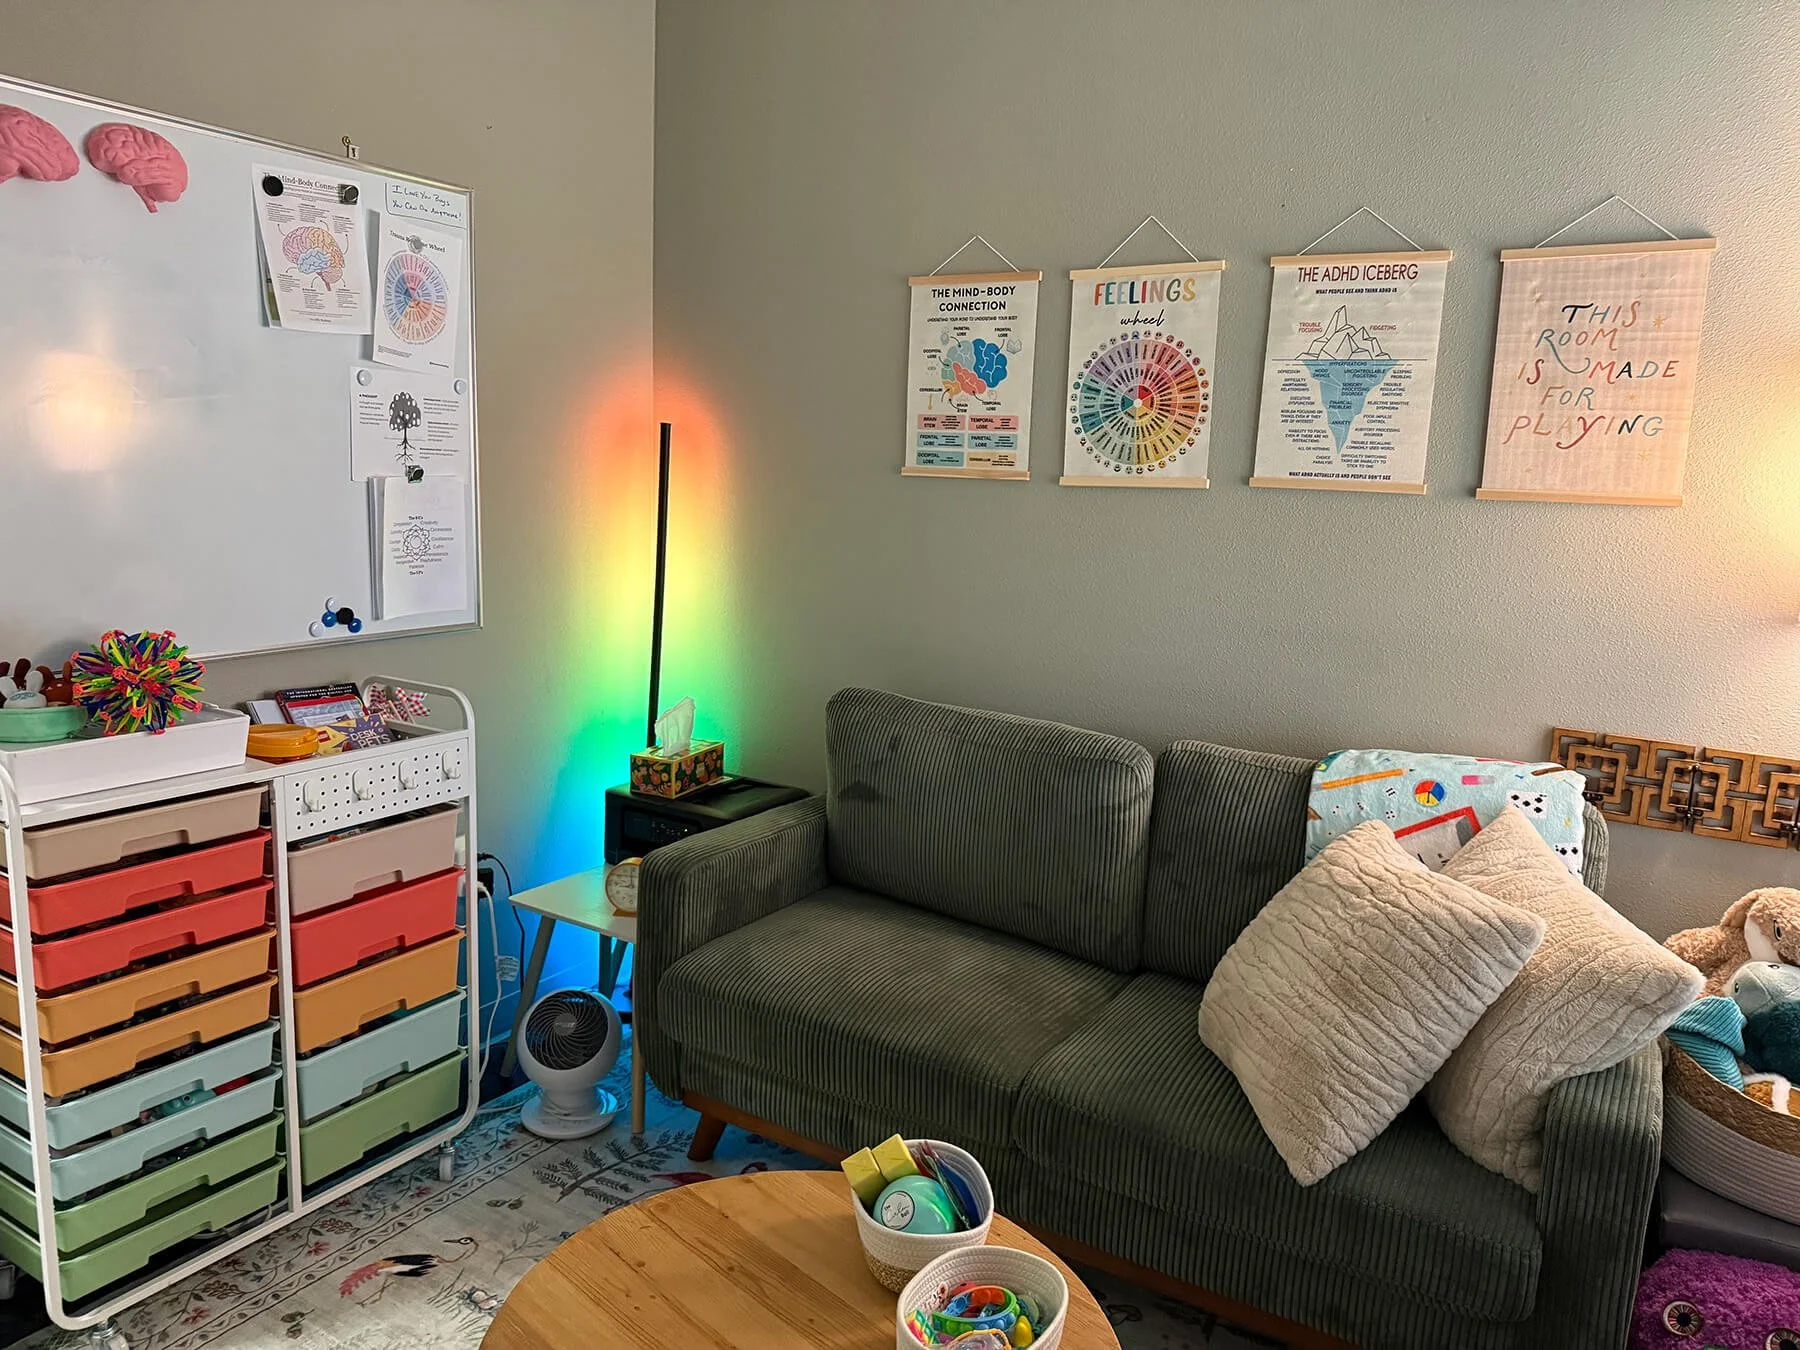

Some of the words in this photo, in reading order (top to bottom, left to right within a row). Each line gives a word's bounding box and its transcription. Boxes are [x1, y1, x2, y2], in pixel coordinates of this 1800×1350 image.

[1298, 266, 1319, 283] THE
[1321, 265, 1360, 282] ADHD
[1362, 263, 1418, 281] ICEBERG
[932, 288, 950, 298] THE
[952, 285, 1016, 297] MIND-BODY
[1094, 278, 1196, 306] FEELINGS
[939, 301, 1006, 312] CONNECTION
[1562, 300, 1640, 327] THIS
[1120, 309, 1165, 327] wheel
[1518, 359, 1544, 385] IS
[1589, 360, 1679, 385] MADE
[1541, 386, 1595, 410] FOR
[1503, 413, 1663, 449] PLAYING
[350, 728, 377, 741] DESK
[358, 733, 390, 750] PETS
